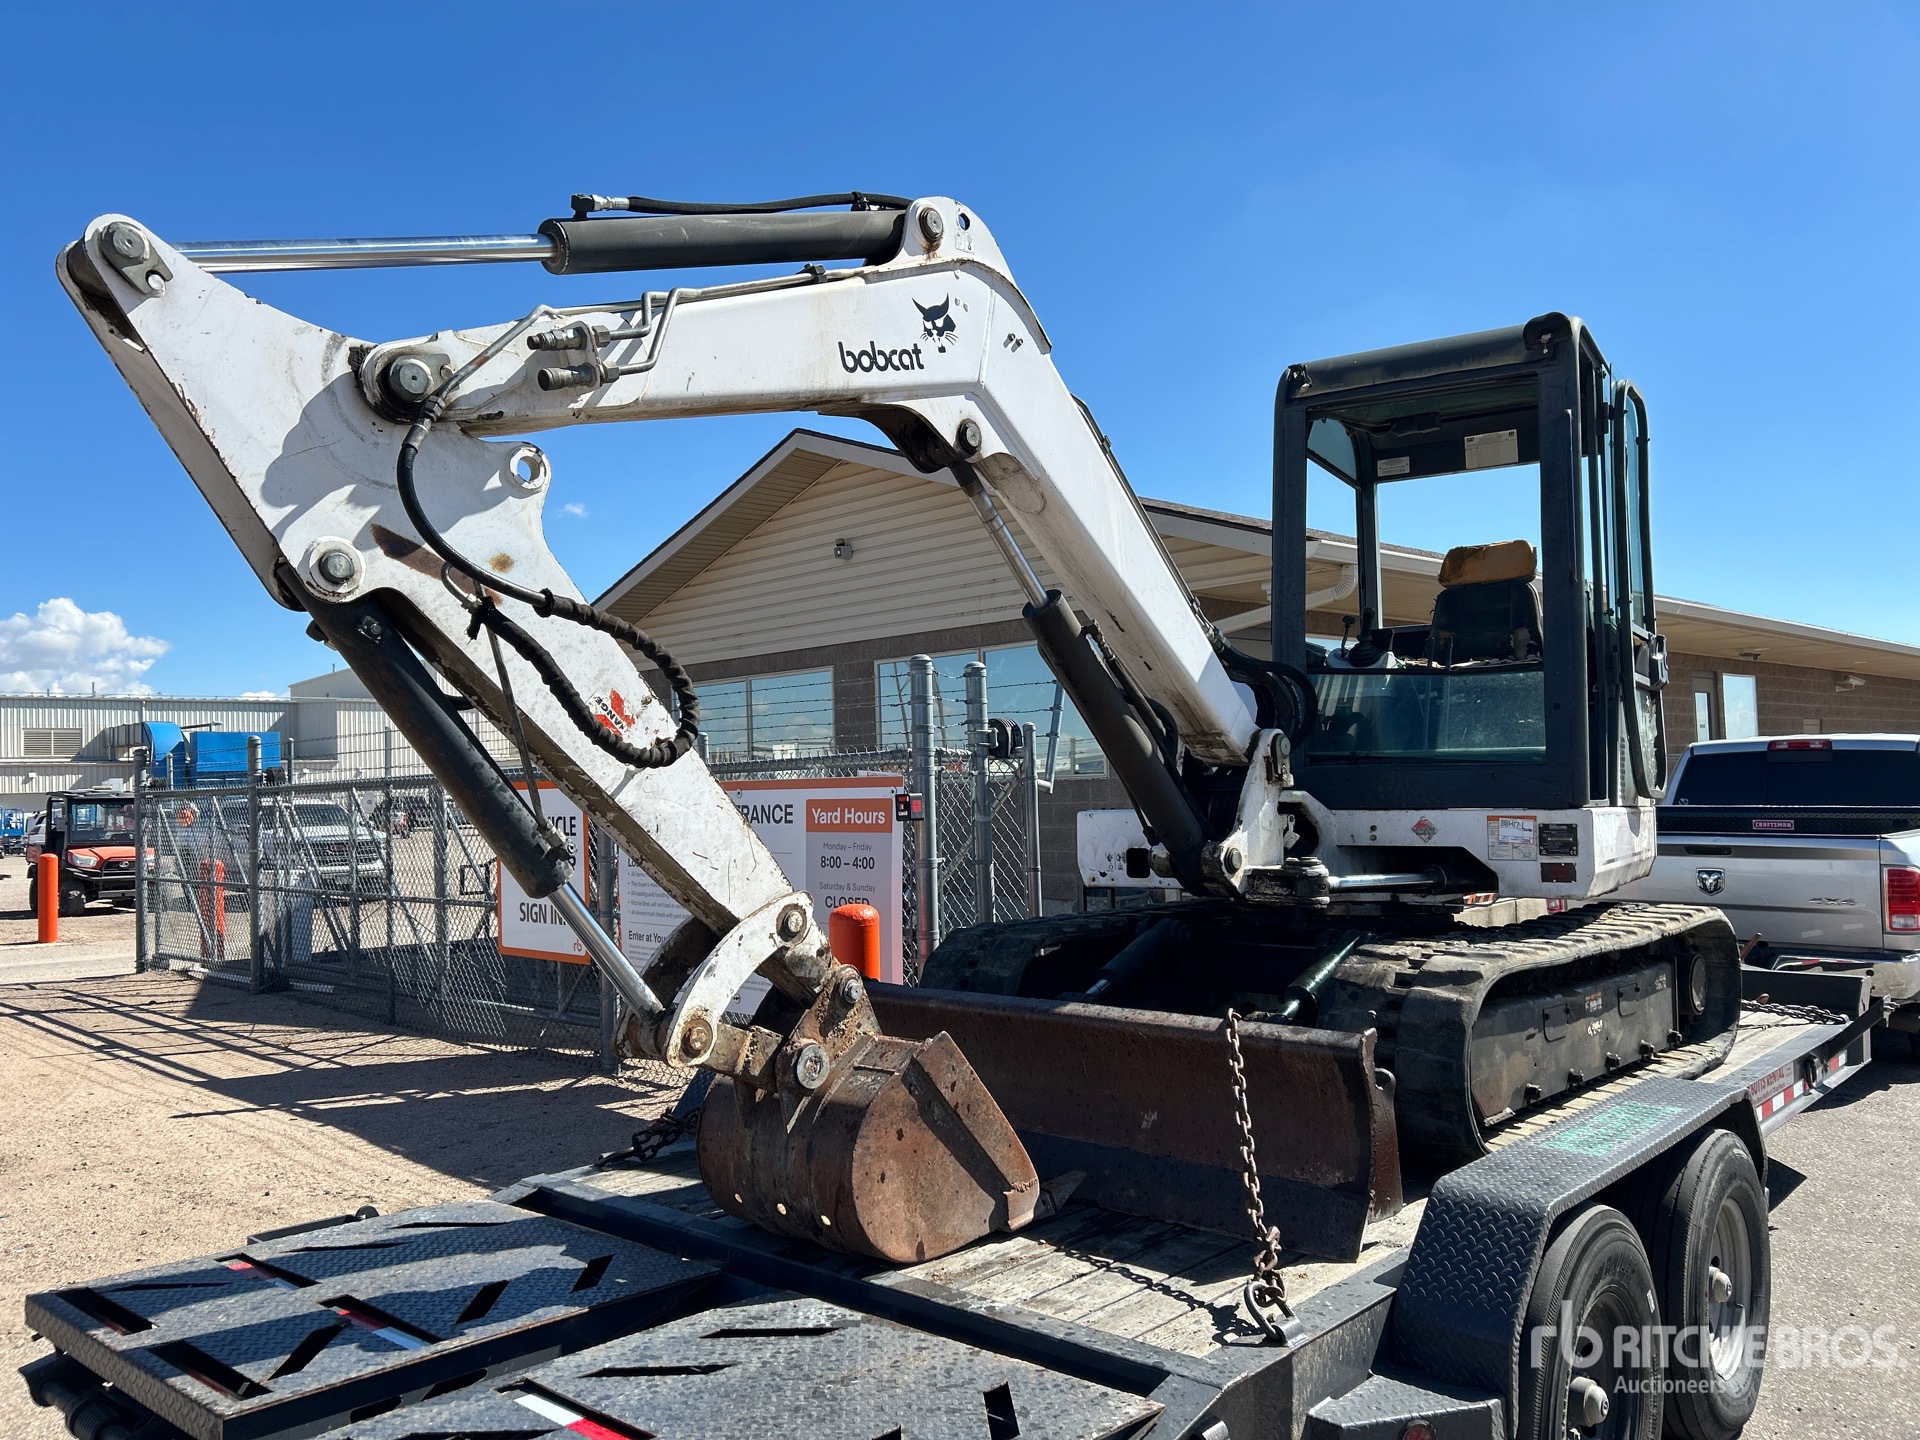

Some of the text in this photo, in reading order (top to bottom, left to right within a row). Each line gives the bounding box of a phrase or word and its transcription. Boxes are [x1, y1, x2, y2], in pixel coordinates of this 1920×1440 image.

[838, 340, 925, 374] bobcat
[736, 803, 793, 824] RANCE
[811, 807, 886, 825] Yard Hours
[823, 842, 847, 851] Monday
[852, 842, 873, 851] Friday
[820, 856, 842, 869] 8:00
[852, 856, 875, 870] 4:00
[819, 882, 876, 893] Saturday & Sunday
[519, 902, 547, 924] SIGN
[628, 930, 644, 941] Enter
[646, 933, 652, 942] at
